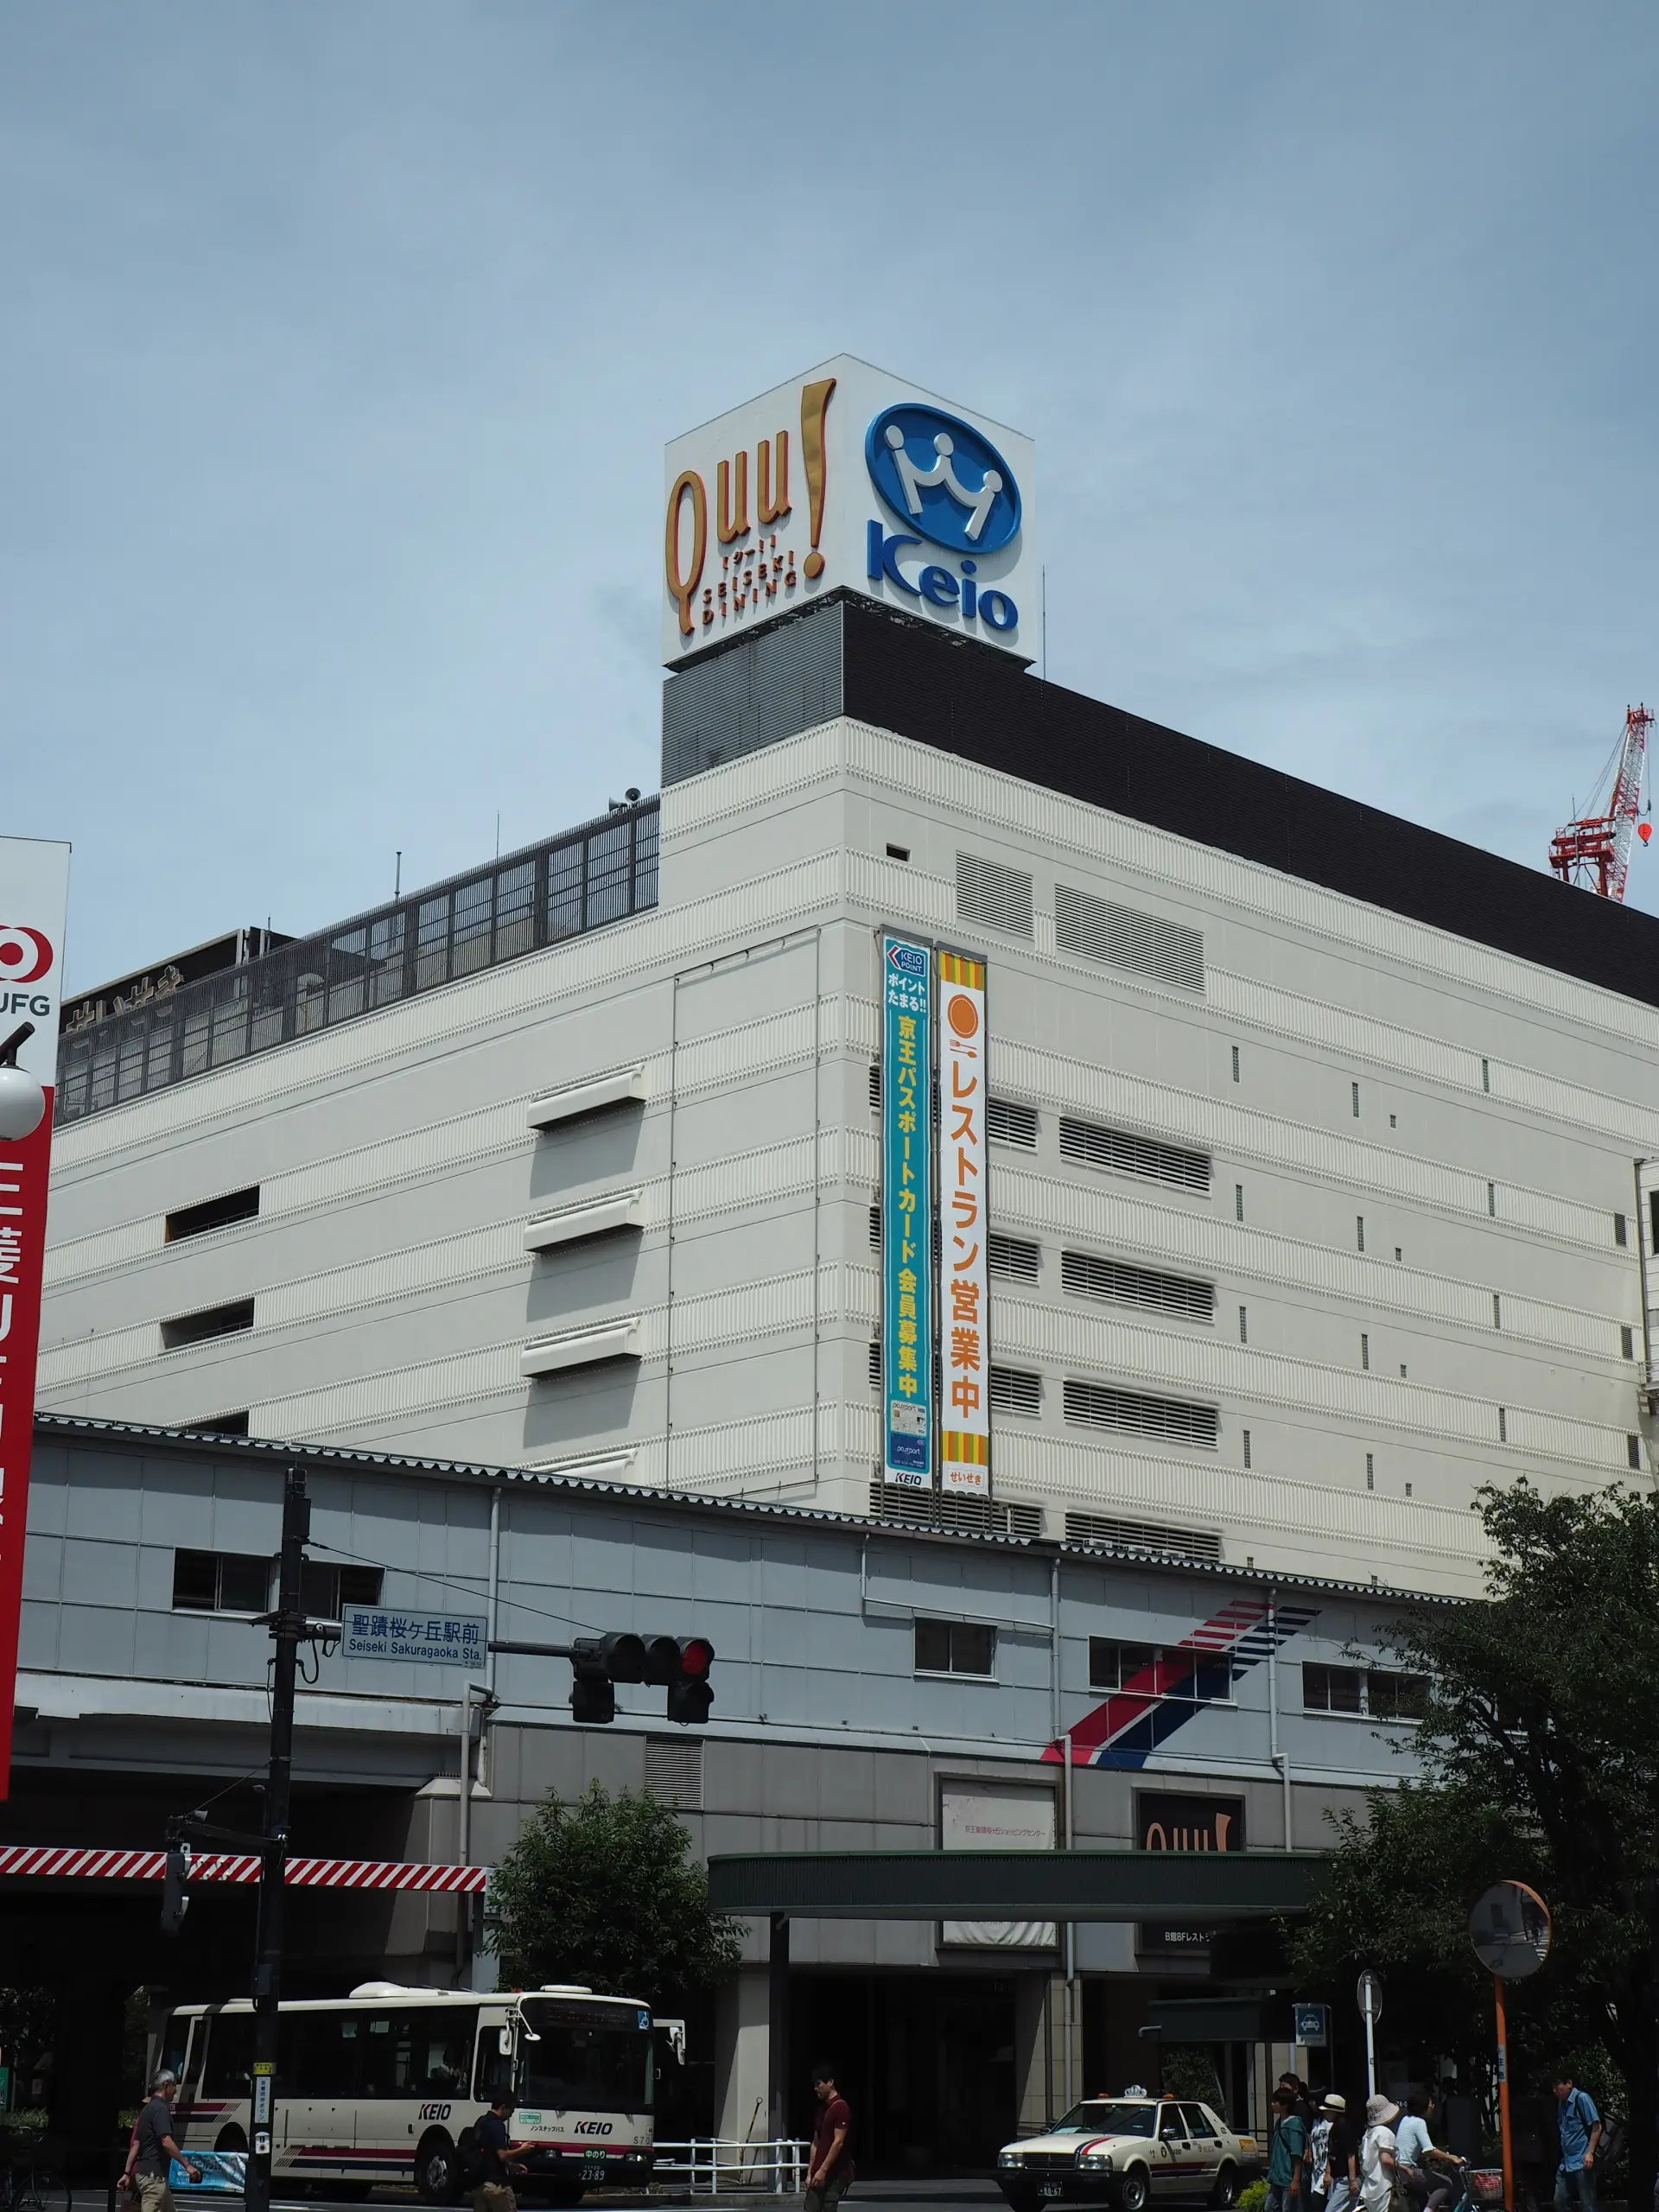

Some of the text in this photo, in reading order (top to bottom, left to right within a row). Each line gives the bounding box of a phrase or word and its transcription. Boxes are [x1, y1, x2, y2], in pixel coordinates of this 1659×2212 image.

[665, 378, 836, 636] Quu!
[702, 550, 794, 604] SEISEKI
[867, 519, 1018, 630] Keio
[702, 569, 797, 625] DINING
[900, 961, 923, 973] POINT
[901, 951, 923, 965] KEIO
[888, 972, 925, 995] ポイント
[950, 1060, 981, 1419] レストラン営業中
[895, 1471, 922, 1485] KEIO
[950, 1471, 982, 1486] せいせき
[349, 1638, 482, 1661] Seiseki Sakuragaoka Sta.
[418, 2103, 452, 2120] KEIO
[575, 2121, 613, 2135] KEIO
[585, 2150, 606, 2159] 中のり
